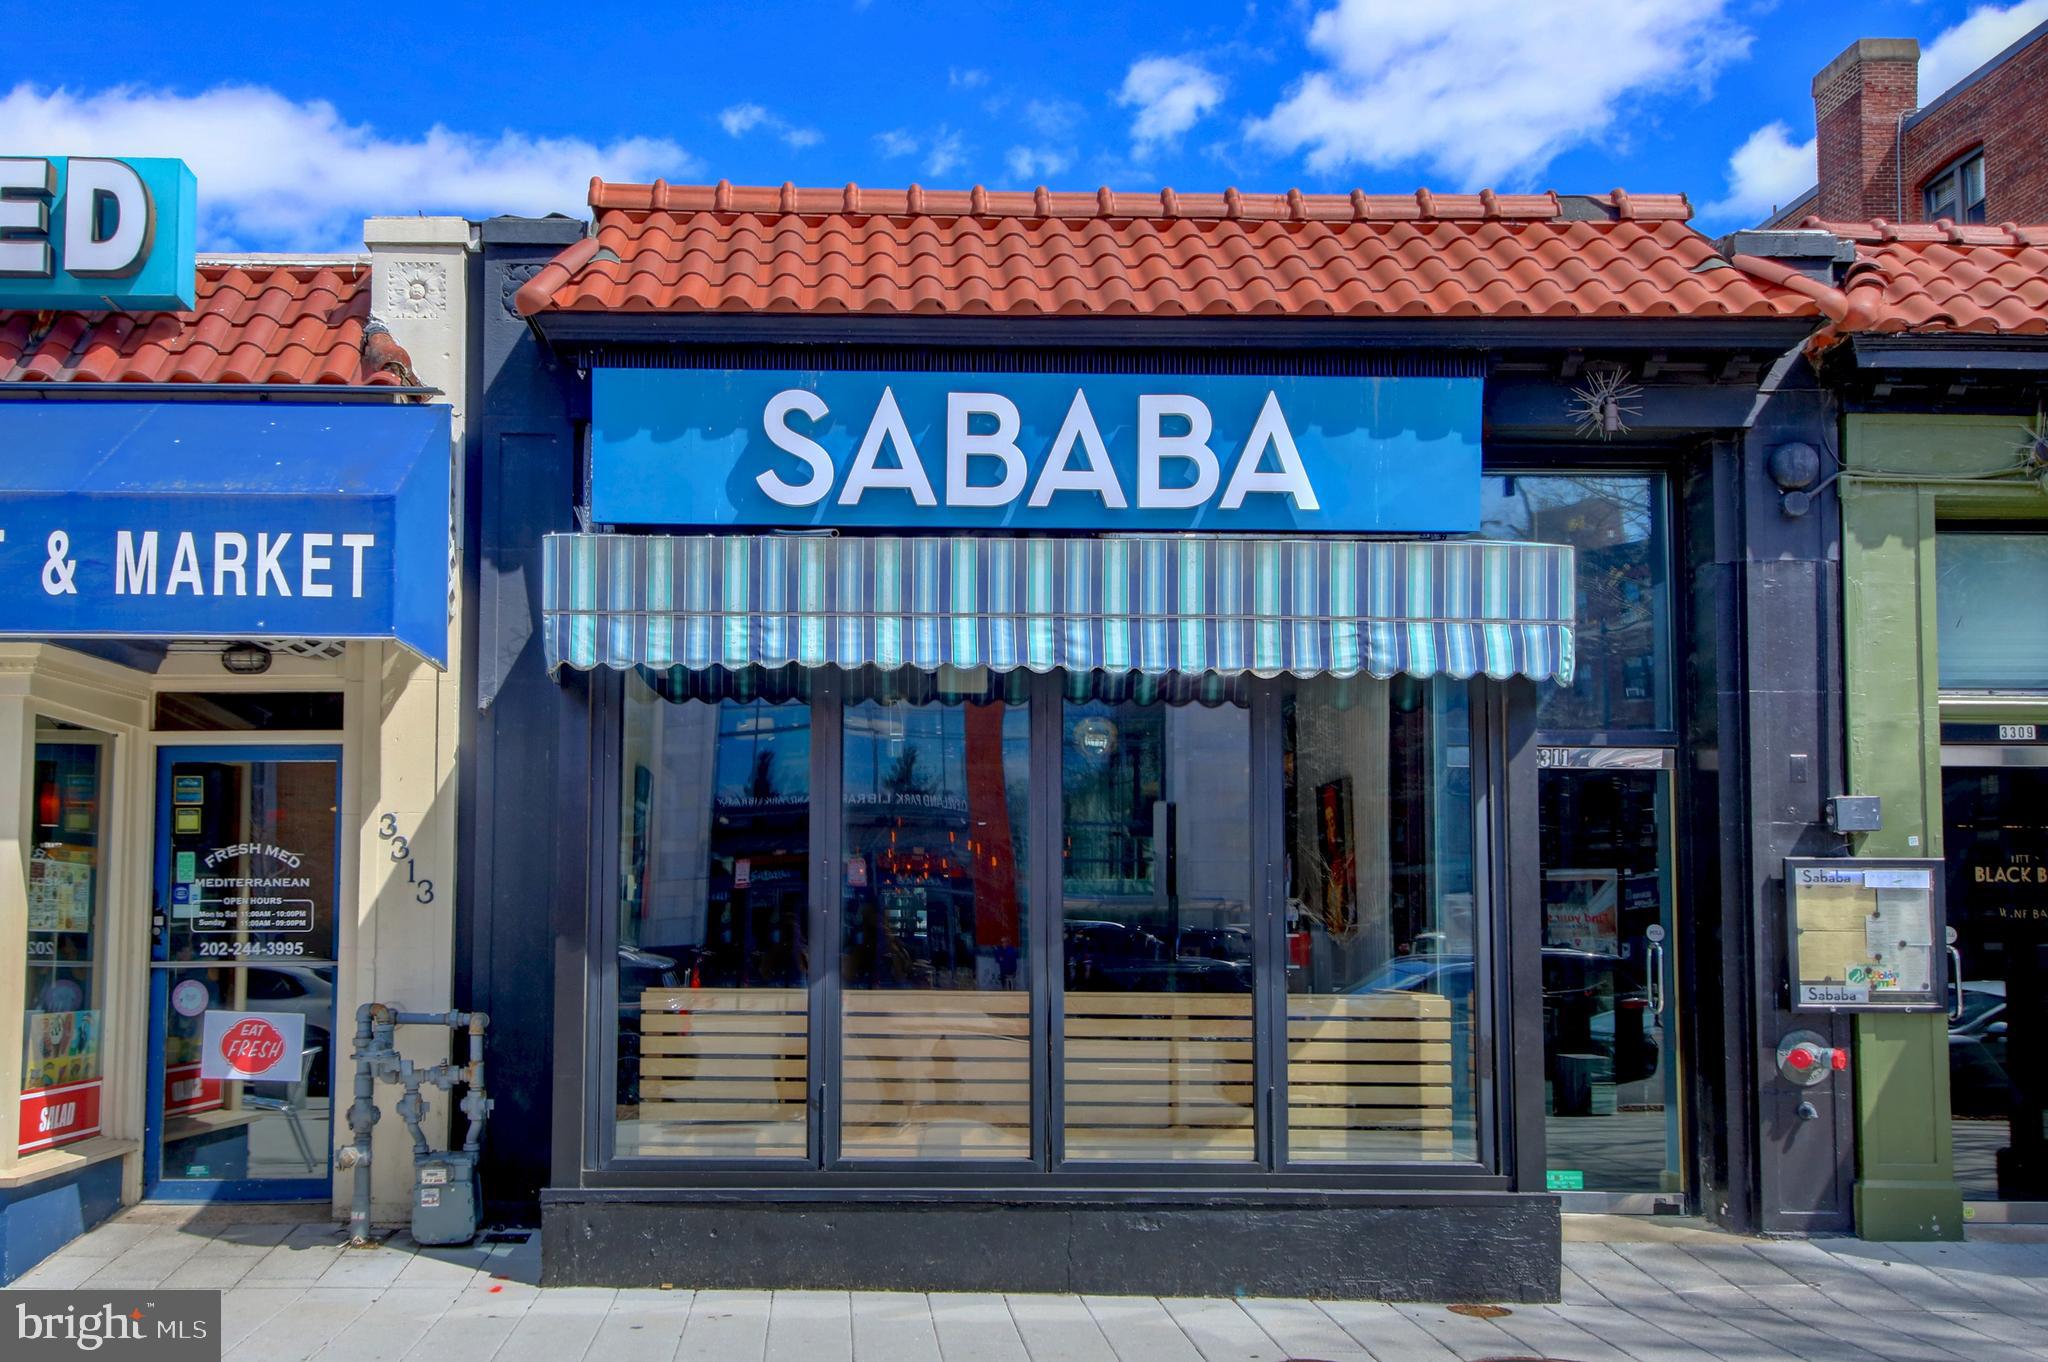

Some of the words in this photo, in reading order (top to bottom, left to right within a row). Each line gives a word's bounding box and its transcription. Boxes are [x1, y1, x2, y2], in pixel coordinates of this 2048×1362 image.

[755, 385, 1320, 511] SABABA
[41, 530, 77, 596] &
[115, 531, 375, 598] MARKET
[2001, 726, 2034, 739] 3309
[1536, 749, 1568, 767] 311
[204, 843, 261, 869] FRESH
[264, 844, 301, 869] MED
[1803, 870, 1851, 883] Sababa
[1974, 866, 2032, 883] BLACK
[194, 878, 311, 888] MEDITERRANEAN
[223, 897, 249, 905] OPEN
[250, 897, 283, 905] HOURS
[225, 910, 237, 918] Sat
[199, 919, 227, 927] Sunday
[200, 942, 304, 956] 202-244-3995
[1808, 987, 1857, 1001] Sababa
[239, 1023, 266, 1037] EAT
[227, 1039, 283, 1059] FRESH
[38, 1102, 77, 1133] SALAD
